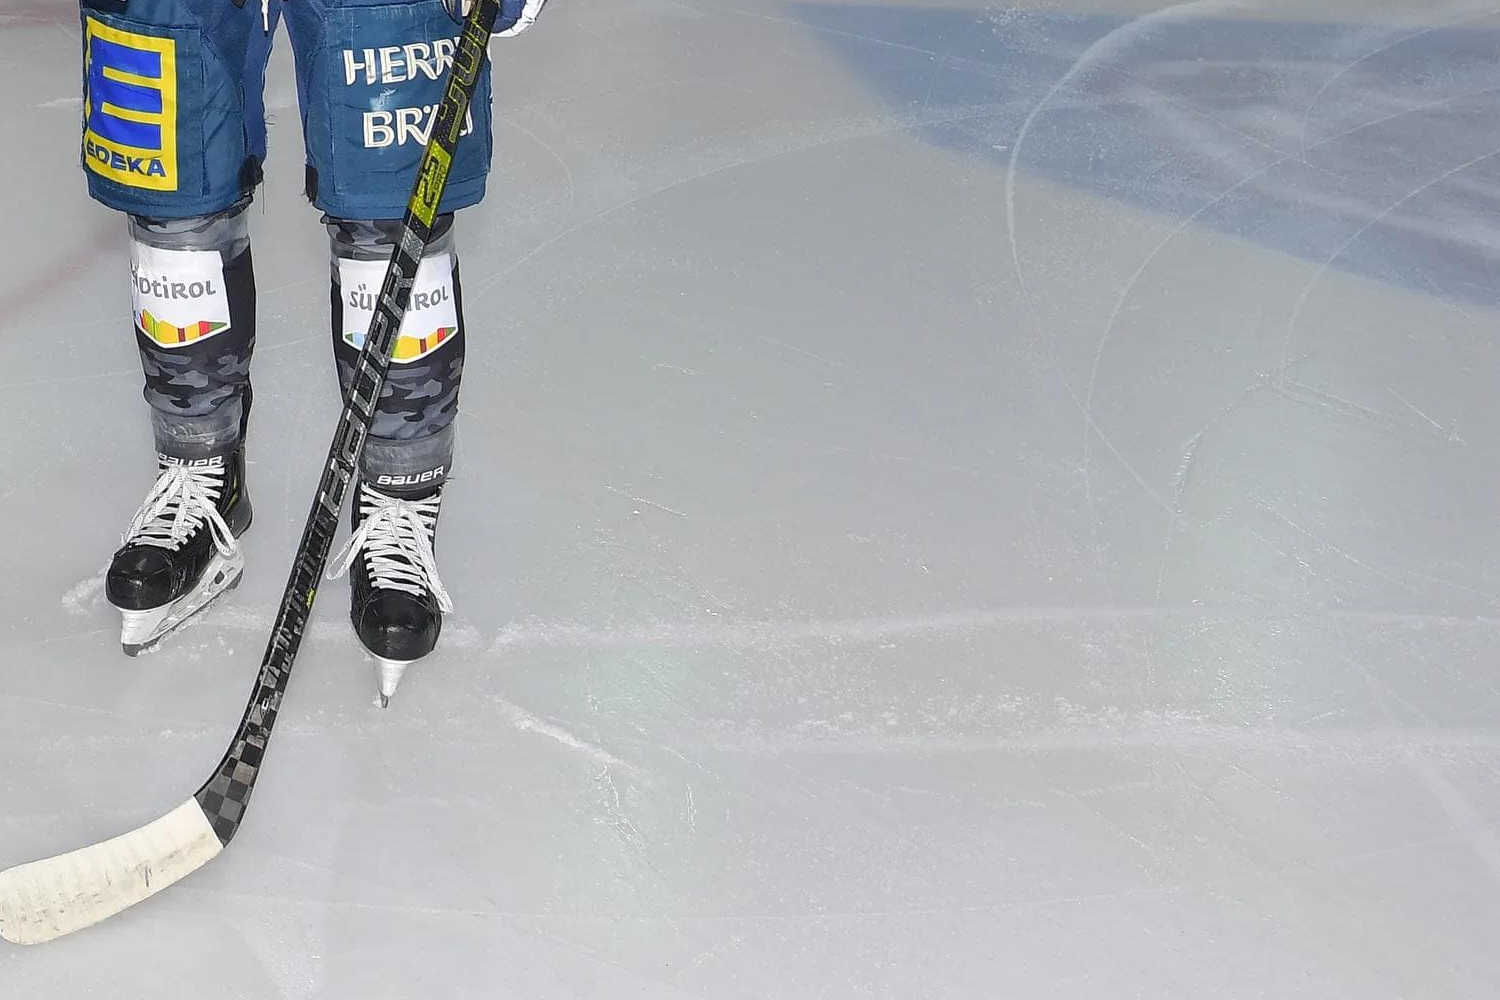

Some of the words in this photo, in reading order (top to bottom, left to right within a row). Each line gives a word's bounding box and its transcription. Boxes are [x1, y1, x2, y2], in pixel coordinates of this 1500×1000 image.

[343, 36, 460, 86] HERR
[86, 136, 167, 179] EDEKA
[376, 465, 445, 486] BAUER
